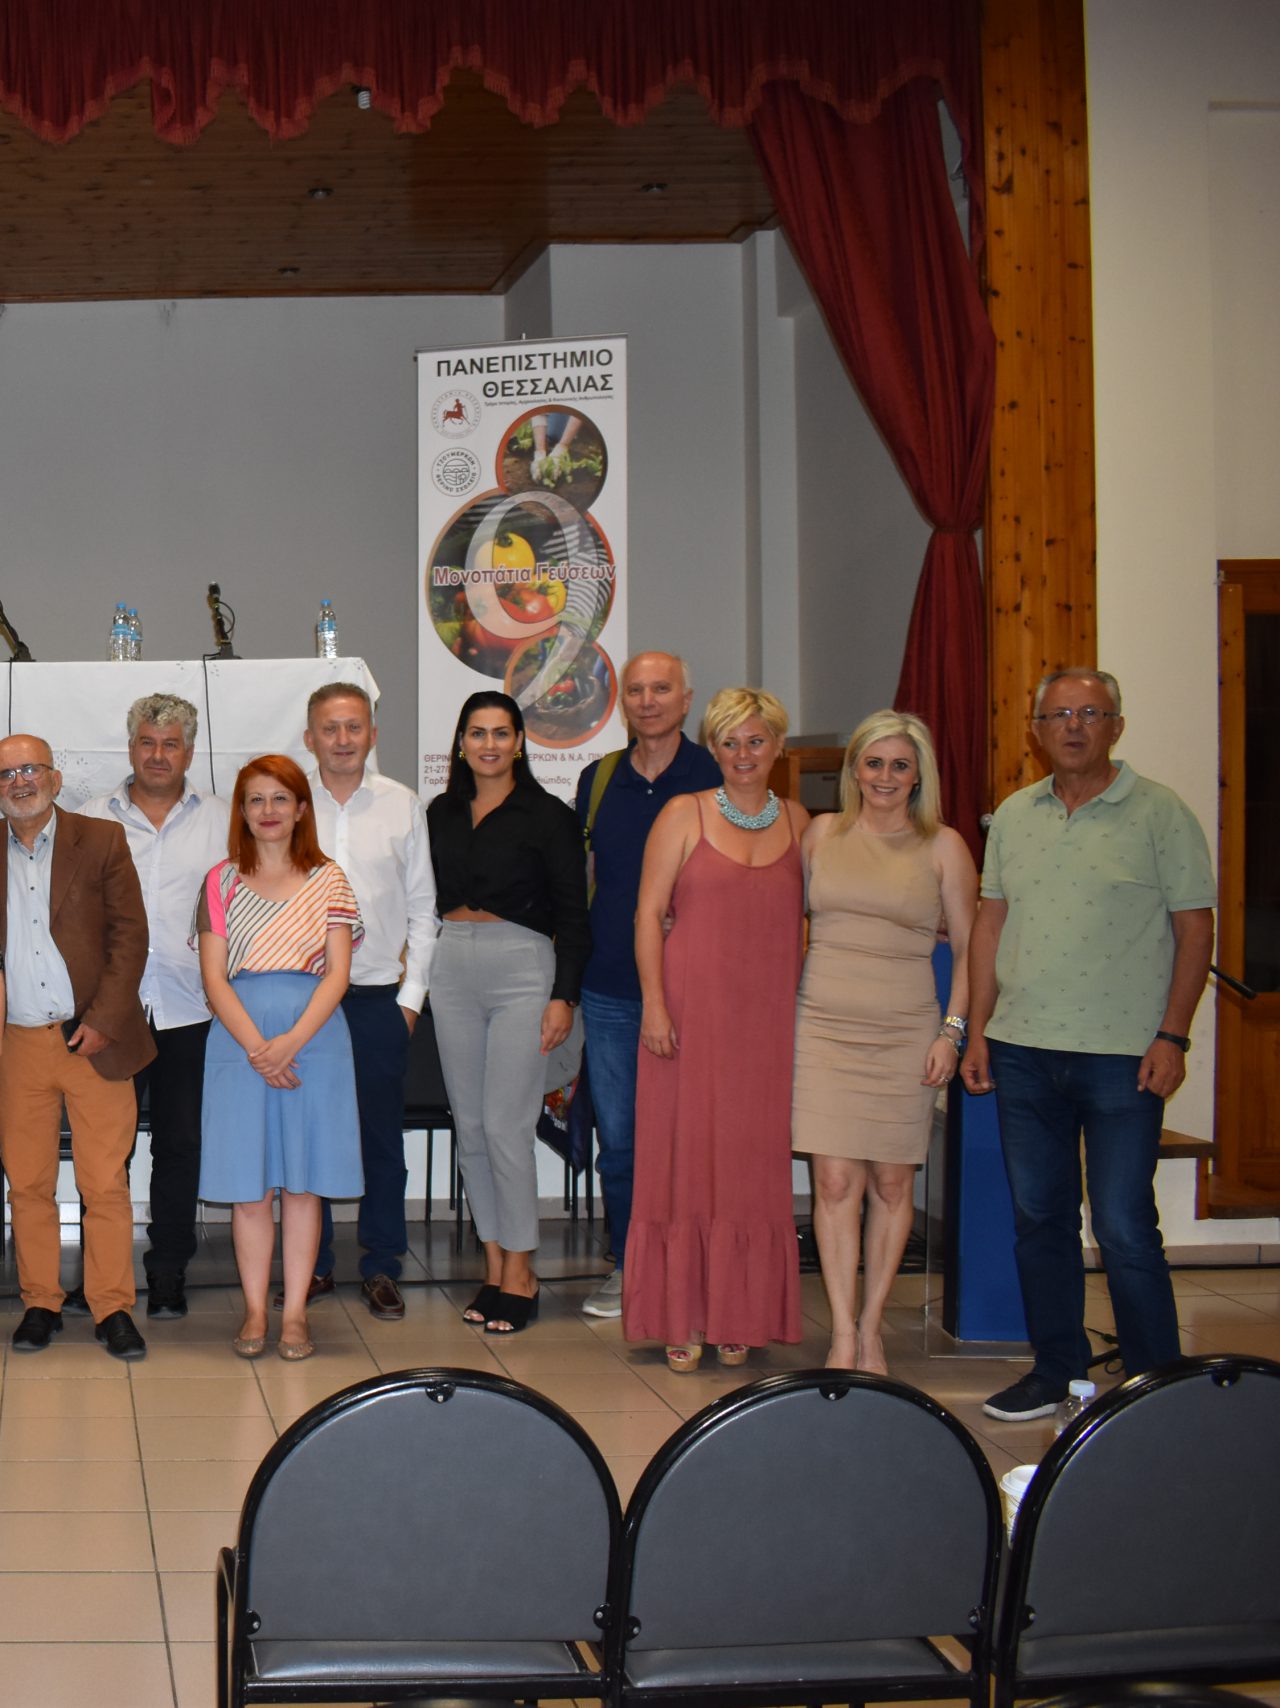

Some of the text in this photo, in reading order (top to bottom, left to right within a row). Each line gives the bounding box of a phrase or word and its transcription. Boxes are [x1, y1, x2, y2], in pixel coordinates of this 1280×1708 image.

[437, 349, 613, 377] ΠΑΝΕΠΙΣΤΗΜΙΟ
[483, 374, 613, 398] ΘΕΣΣΑΛΙΑΣ
[433, 562, 616, 585] Μονοπάτια Γεύσεων
[424, 754, 450, 763] ΘΕΡΙΝ
[528, 753, 558, 762] ΕΡΚΩΝ
[560, 753, 566, 761] &
[588, 752, 606, 761] ΠΙΝ
[424, 775, 572, 787] Γαρδί θιώτιδος
